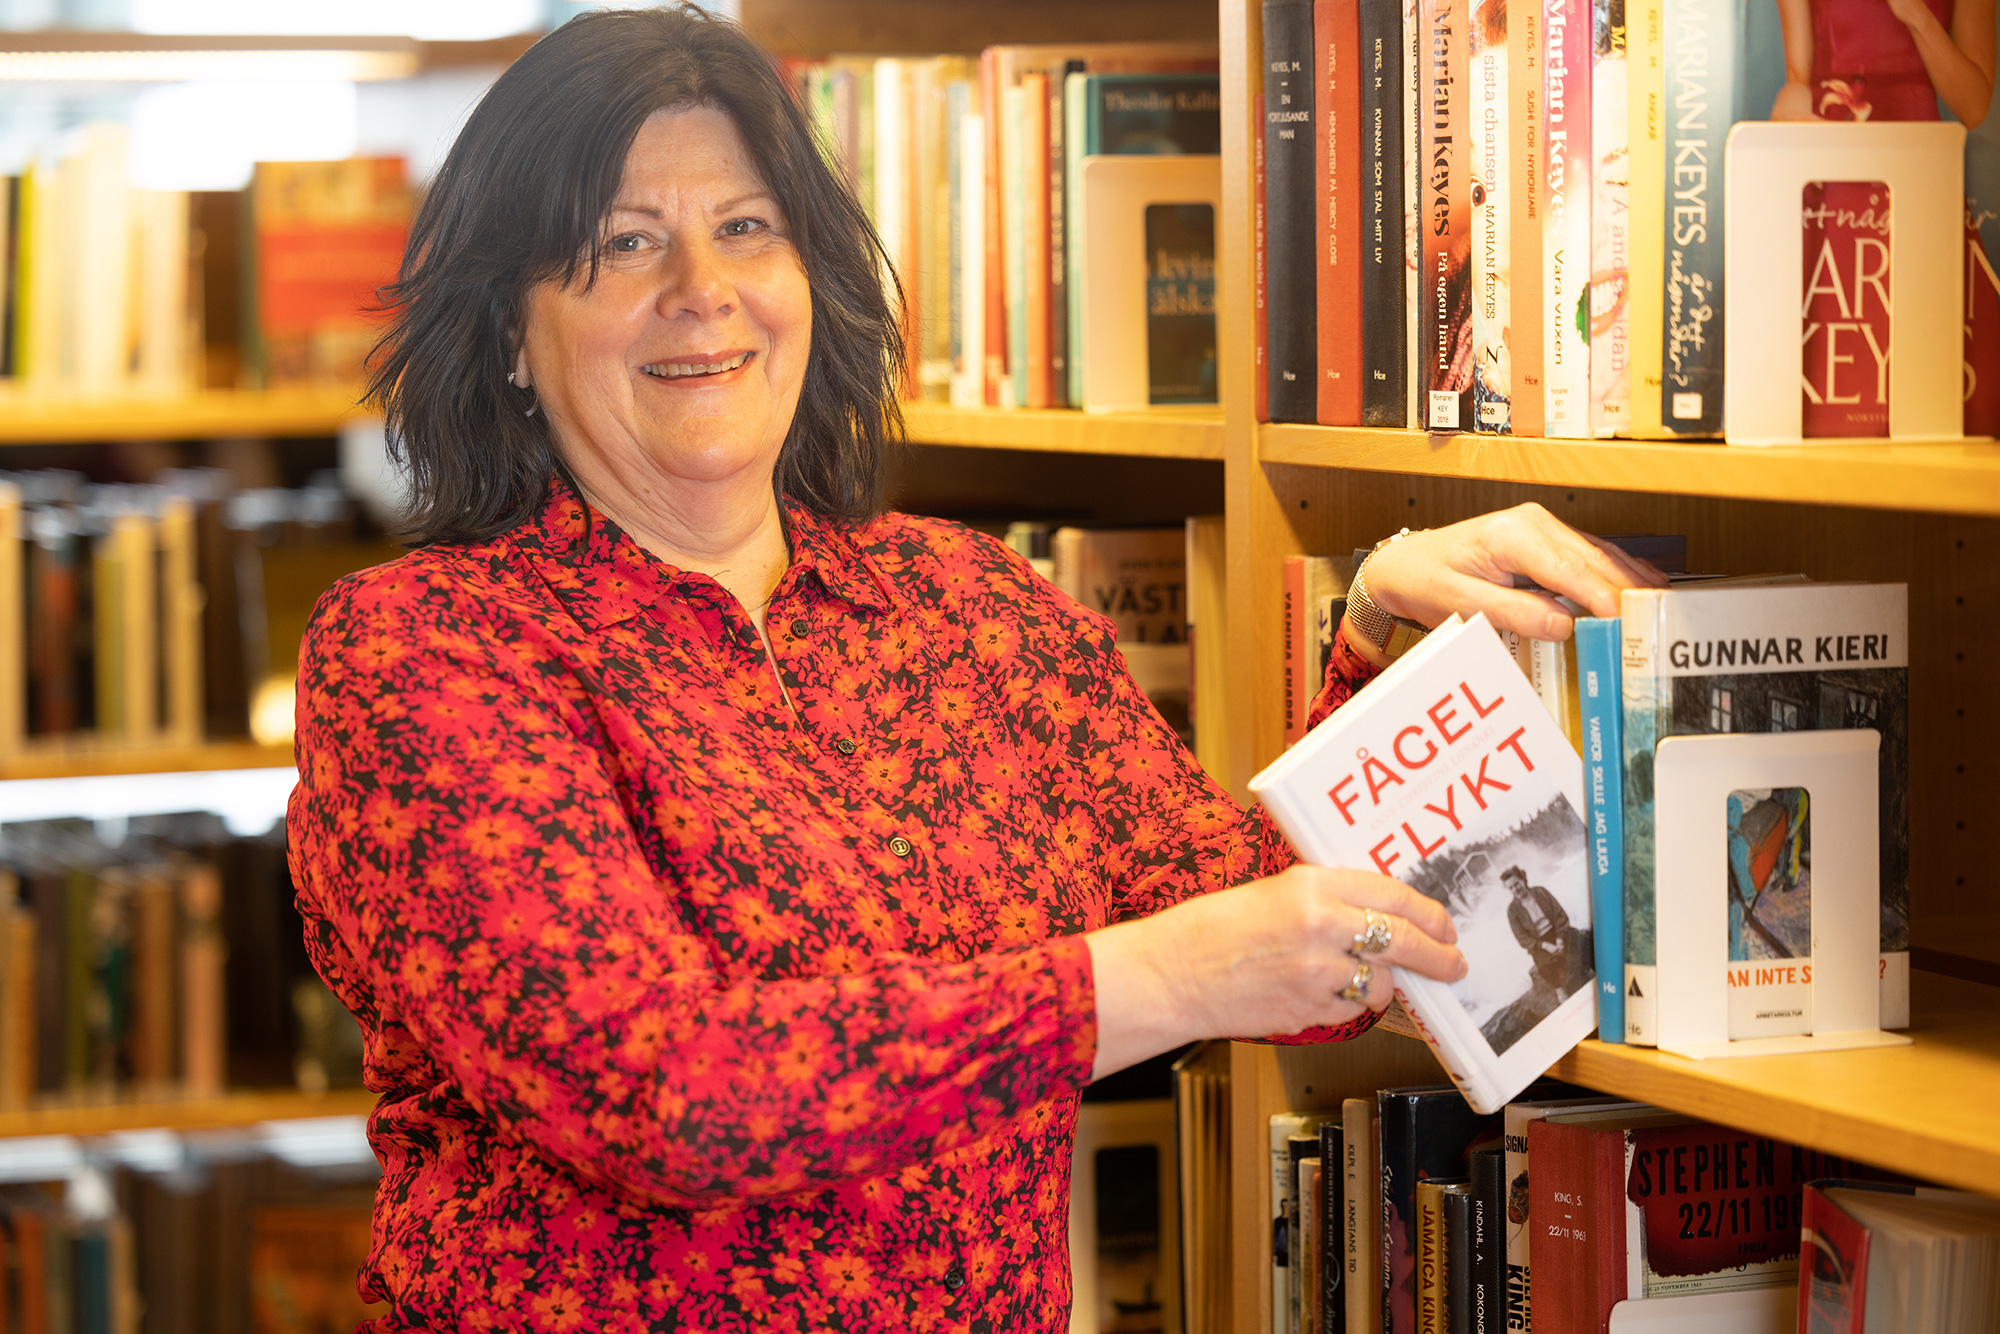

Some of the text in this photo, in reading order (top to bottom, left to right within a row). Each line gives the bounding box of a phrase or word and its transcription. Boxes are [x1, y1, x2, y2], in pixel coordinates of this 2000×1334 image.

[1527, 16, 1535, 52] KEYES,
[1281, 94, 1291, 105] EN
[1329, 80, 1336, 93] M.
[1527, 90, 1535, 121] SUSHI
[1279, 130, 1294, 140] MAN
[1430, 6, 1454, 236] Marian Keyes
[1547, 0, 1568, 235] Marian Keyes
[1374, 38, 1382, 264] KEYES, M. KVINNAN SOM STAL MITT LIV
[1484, 55, 1498, 319] sista chansen MARIAN KEYES
[1673, 139, 1708, 246] KEYES
[1612, 225, 1627, 296] andra
[1436, 252, 1449, 370] På egen hand
[1555, 249, 1563, 365] Vara vuxen
[1612, 305, 1627, 372] sidan
[1374, 369, 1386, 380] Hce
[1433, 394, 1453, 402] Romaner
[1437, 405, 1448, 413] KEY
[1481, 402, 1495, 415] Hce
[1437, 416, 1449, 424] 2018
[1669, 637, 1804, 669] GUNNAR
[1815, 634, 1888, 664] KIERI
[1327, 680, 1505, 827] FÅGEL
[1369, 727, 1535, 876] FLYKT
[1592, 766, 1606, 806] SKULLE
[1594, 811, 1607, 836] JAG
[1596, 838, 1609, 876] LJUGA
[1755, 967, 1797, 986] INTE
[1637, 1138, 1775, 1198] STEPHEN
[1554, 1192, 1583, 1206] KING, S.
[1678, 1197, 1750, 1239] 22/11
[1383, 1165, 1394, 1290] Stackars Susanna
[1476, 1200, 1484, 1248] KINDAHL,
[1549, 1225, 1586, 1241] 22/11 1963
[1422, 1204, 1435, 1290] JAMAICA
[1477, 1253, 1484, 1265] A.
[1737, 1241, 1768, 1255] ROMAN
[1507, 1264, 1525, 1331] KING
